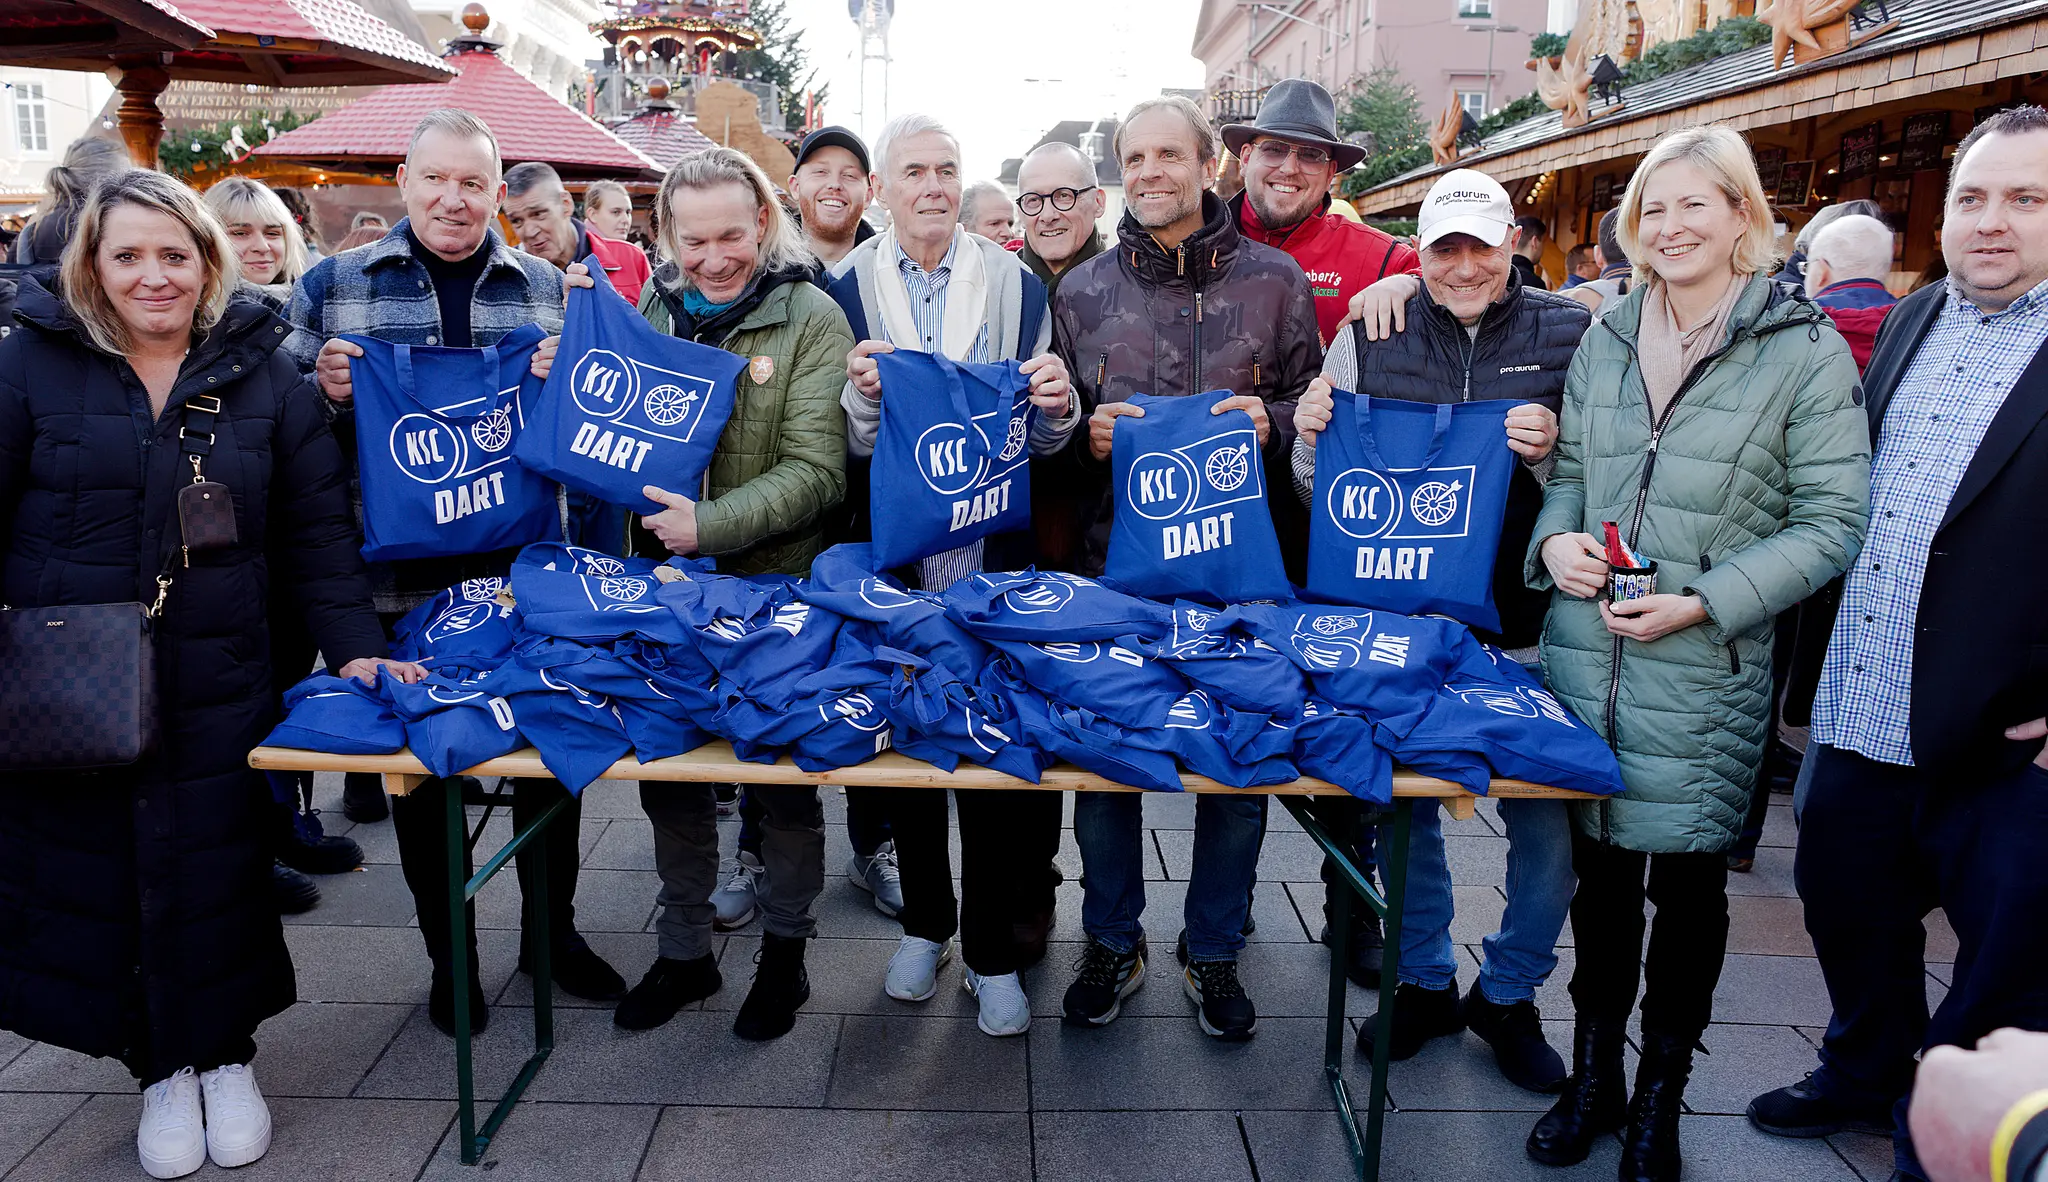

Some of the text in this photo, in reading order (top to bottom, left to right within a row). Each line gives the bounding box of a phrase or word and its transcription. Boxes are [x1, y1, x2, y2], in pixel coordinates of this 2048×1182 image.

[168, 80, 234, 92] MARKGRAF
[191, 95, 239, 106] ERSTEN
[240, 96, 317, 108] GRUNDSTEIN
[181, 109, 242, 120] WOHNSITZ
[1435, 192, 1451, 205] pro
[1452, 190, 1490, 199] aurum
[581, 361, 622, 404] KSC
[1500, 364, 1541, 375] pro aurum
[405, 427, 444, 466] KSC
[569, 421, 653, 473] DART
[929, 436, 968, 478] KSC
[434, 471, 505, 525] DART
[1139, 466, 1178, 505] KSC
[1342, 485, 1380, 520] KSC
[949, 478, 1012, 533] DART
[1162, 511, 1235, 561] DART
[1355, 546, 1434, 580] DART
